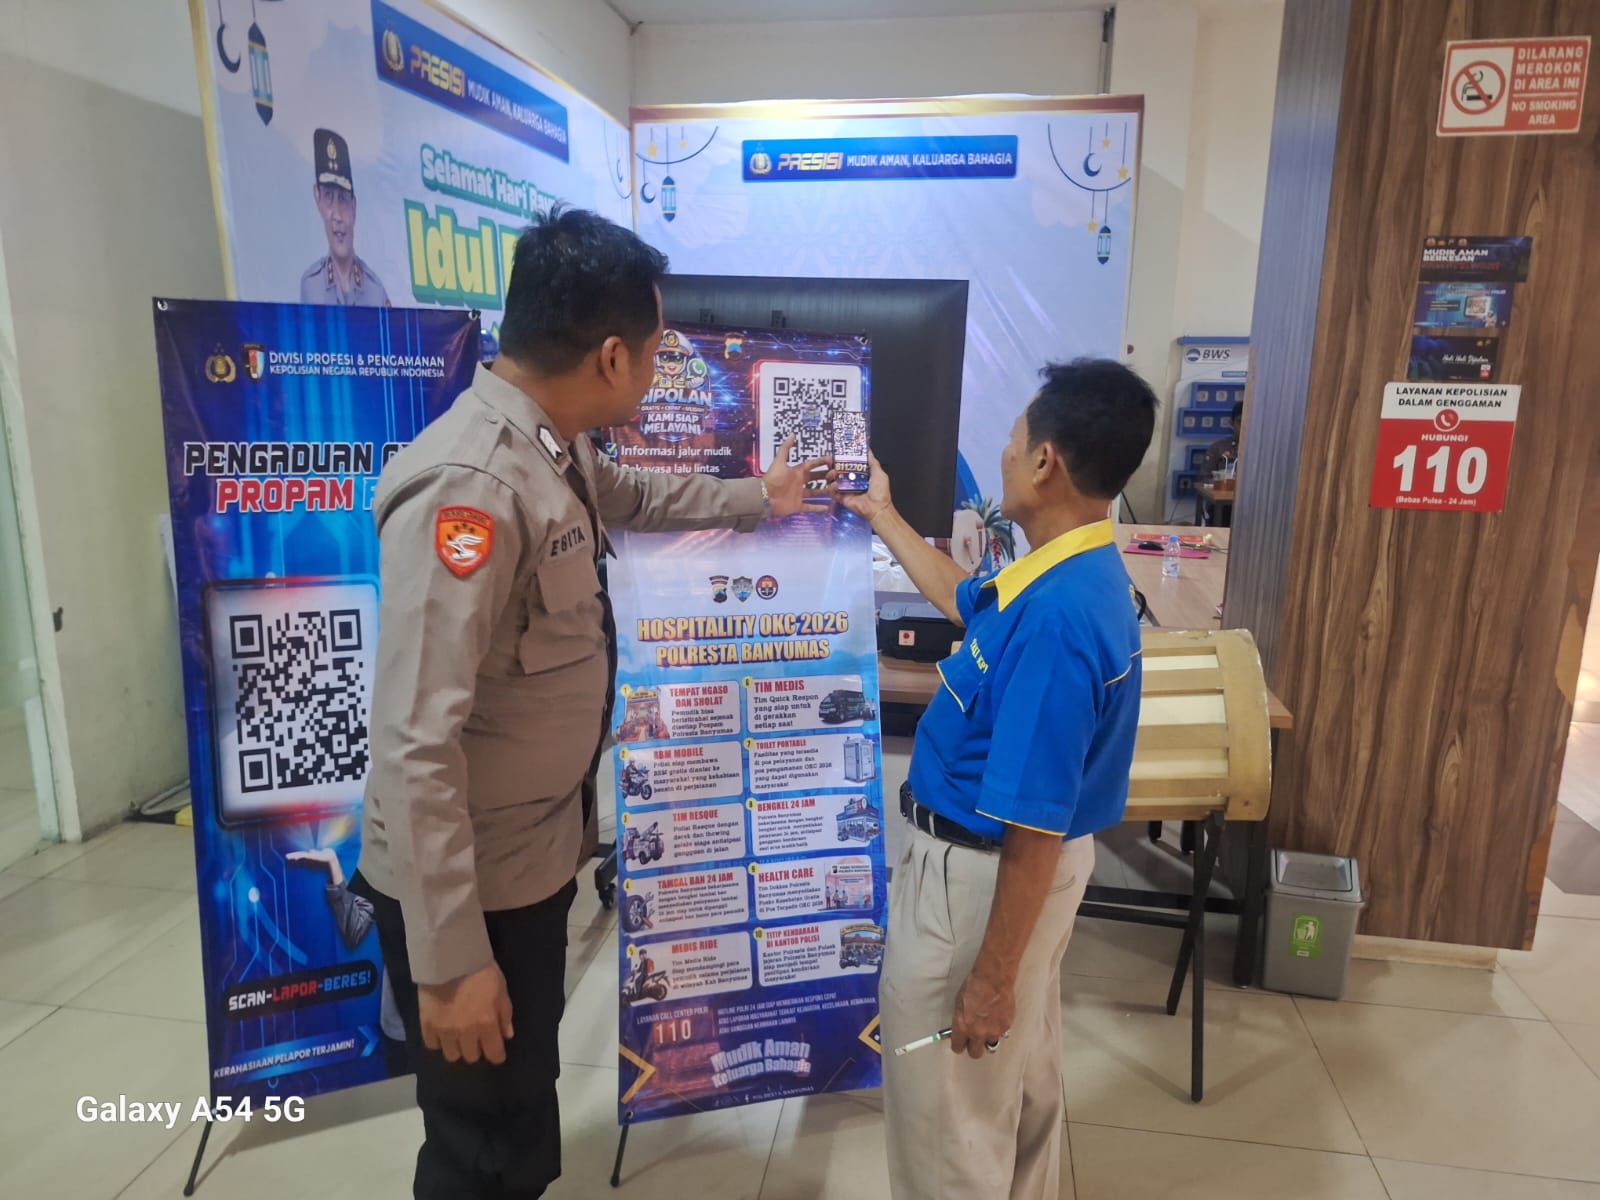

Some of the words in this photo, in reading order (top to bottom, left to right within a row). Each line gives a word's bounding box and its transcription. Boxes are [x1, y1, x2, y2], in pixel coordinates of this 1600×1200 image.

[1518, 46, 1584, 60] DILARANG
[410, 44, 465, 98] PRESISI
[468, 80, 490, 106] MUDIK
[1516, 62, 1582, 75] MEROKOK
[1514, 79, 1526, 90] DI
[1529, 78, 1560, 90] AREA
[1563, 77, 1580, 89] INI
[1511, 101, 1526, 111] NO
[1529, 100, 1577, 111] SMOKING
[1528, 114, 1556, 125] AREA
[777, 152, 844, 171] PRESISI
[847, 153, 878, 168] MUDIK
[879, 153, 911, 169] AMAN,
[912, 152, 965, 167] KALUARGA
[967, 152, 1013, 166] BAHAGIA
[421, 146, 494, 200] Selamat
[495, 172, 528, 211] Hari
[408, 208, 497, 296] Idul
[1424, 249, 1456, 257] MUDIK
[1458, 249, 1489, 257] AMAN
[269, 352, 302, 365] DIVISI
[306, 353, 354, 366] PROFESI
[357, 354, 364, 366] &
[367, 355, 445, 368] PENGAMANAN
[1202, 349, 1231, 359] BWS
[270, 366, 320, 376] KEPOLISIAN
[322, 367, 357, 377] NEGARA
[359, 367, 399, 377] REPUBLIK
[400, 368, 445, 378] INDONESIA
[1396, 387, 1443, 396] LAYANAN
[1446, 388, 1508, 397] KEPOLISIAN
[1398, 398, 1433, 407] DALAM
[1436, 399, 1502, 408] GENGGAMAN
[647, 413, 674, 422] KAMI
[675, 413, 699, 423] SIAP
[643, 422, 702, 435] MELAYANI
[1421, 434, 1469, 442] HUBUNGI
[183, 441, 375, 476] PENGADUAN
[620, 445, 676, 456] Informasi
[677, 446, 701, 459] jalur
[703, 447, 732, 457] mudik
[674, 464, 692, 473] lalu
[694, 464, 720, 474] lintas
[1393, 445, 1488, 495] 110
[216, 477, 355, 514] PROPAM
[1422, 496, 1442, 505] Pulsa
[636, 615, 756, 642] HOSPITALITY
[759, 613, 799, 637] OKC
[798, 611, 849, 636] 2026
[656, 643, 739, 668] POLRESTA
[741, 639, 831, 663] BANYUMAS
[670, 687, 700, 697] TEMPAT
[702, 685, 728, 695] NGASO
[754, 681, 772, 693] TIM
[775, 680, 805, 692] MEDIS
[675, 698, 692, 707] DAN
[694, 696, 723, 706] SHOLAT
[769, 695, 790, 703] Quick
[674, 747, 704, 758] MOBILE
[756, 742, 775, 750] TOILET
[758, 801, 789, 812] BENGKEL
[790, 799, 800, 809] 24
[801, 798, 816, 808] JAM
[689, 809, 718, 820] RESQUE
[707, 873, 717, 884] 24
[718, 871, 734, 882] JAM
[758, 870, 790, 883] HEALTH
[792, 867, 815, 880] CARE
[228, 970, 371, 1012] SCAN-LAPOR-BERES!
[655, 1019, 692, 1044] 110
[213, 1055, 274, 1079] KERAHASIAAN
[274, 1047, 312, 1065] PELAPOR
[311, 1038, 355, 1057] TERJAMIN!
[710, 1040, 763, 1073] Mudik
[764, 1038, 811, 1059] Aman
[712, 1061, 765, 1089] Keluarga
[764, 1057, 812, 1074] Bahagia
